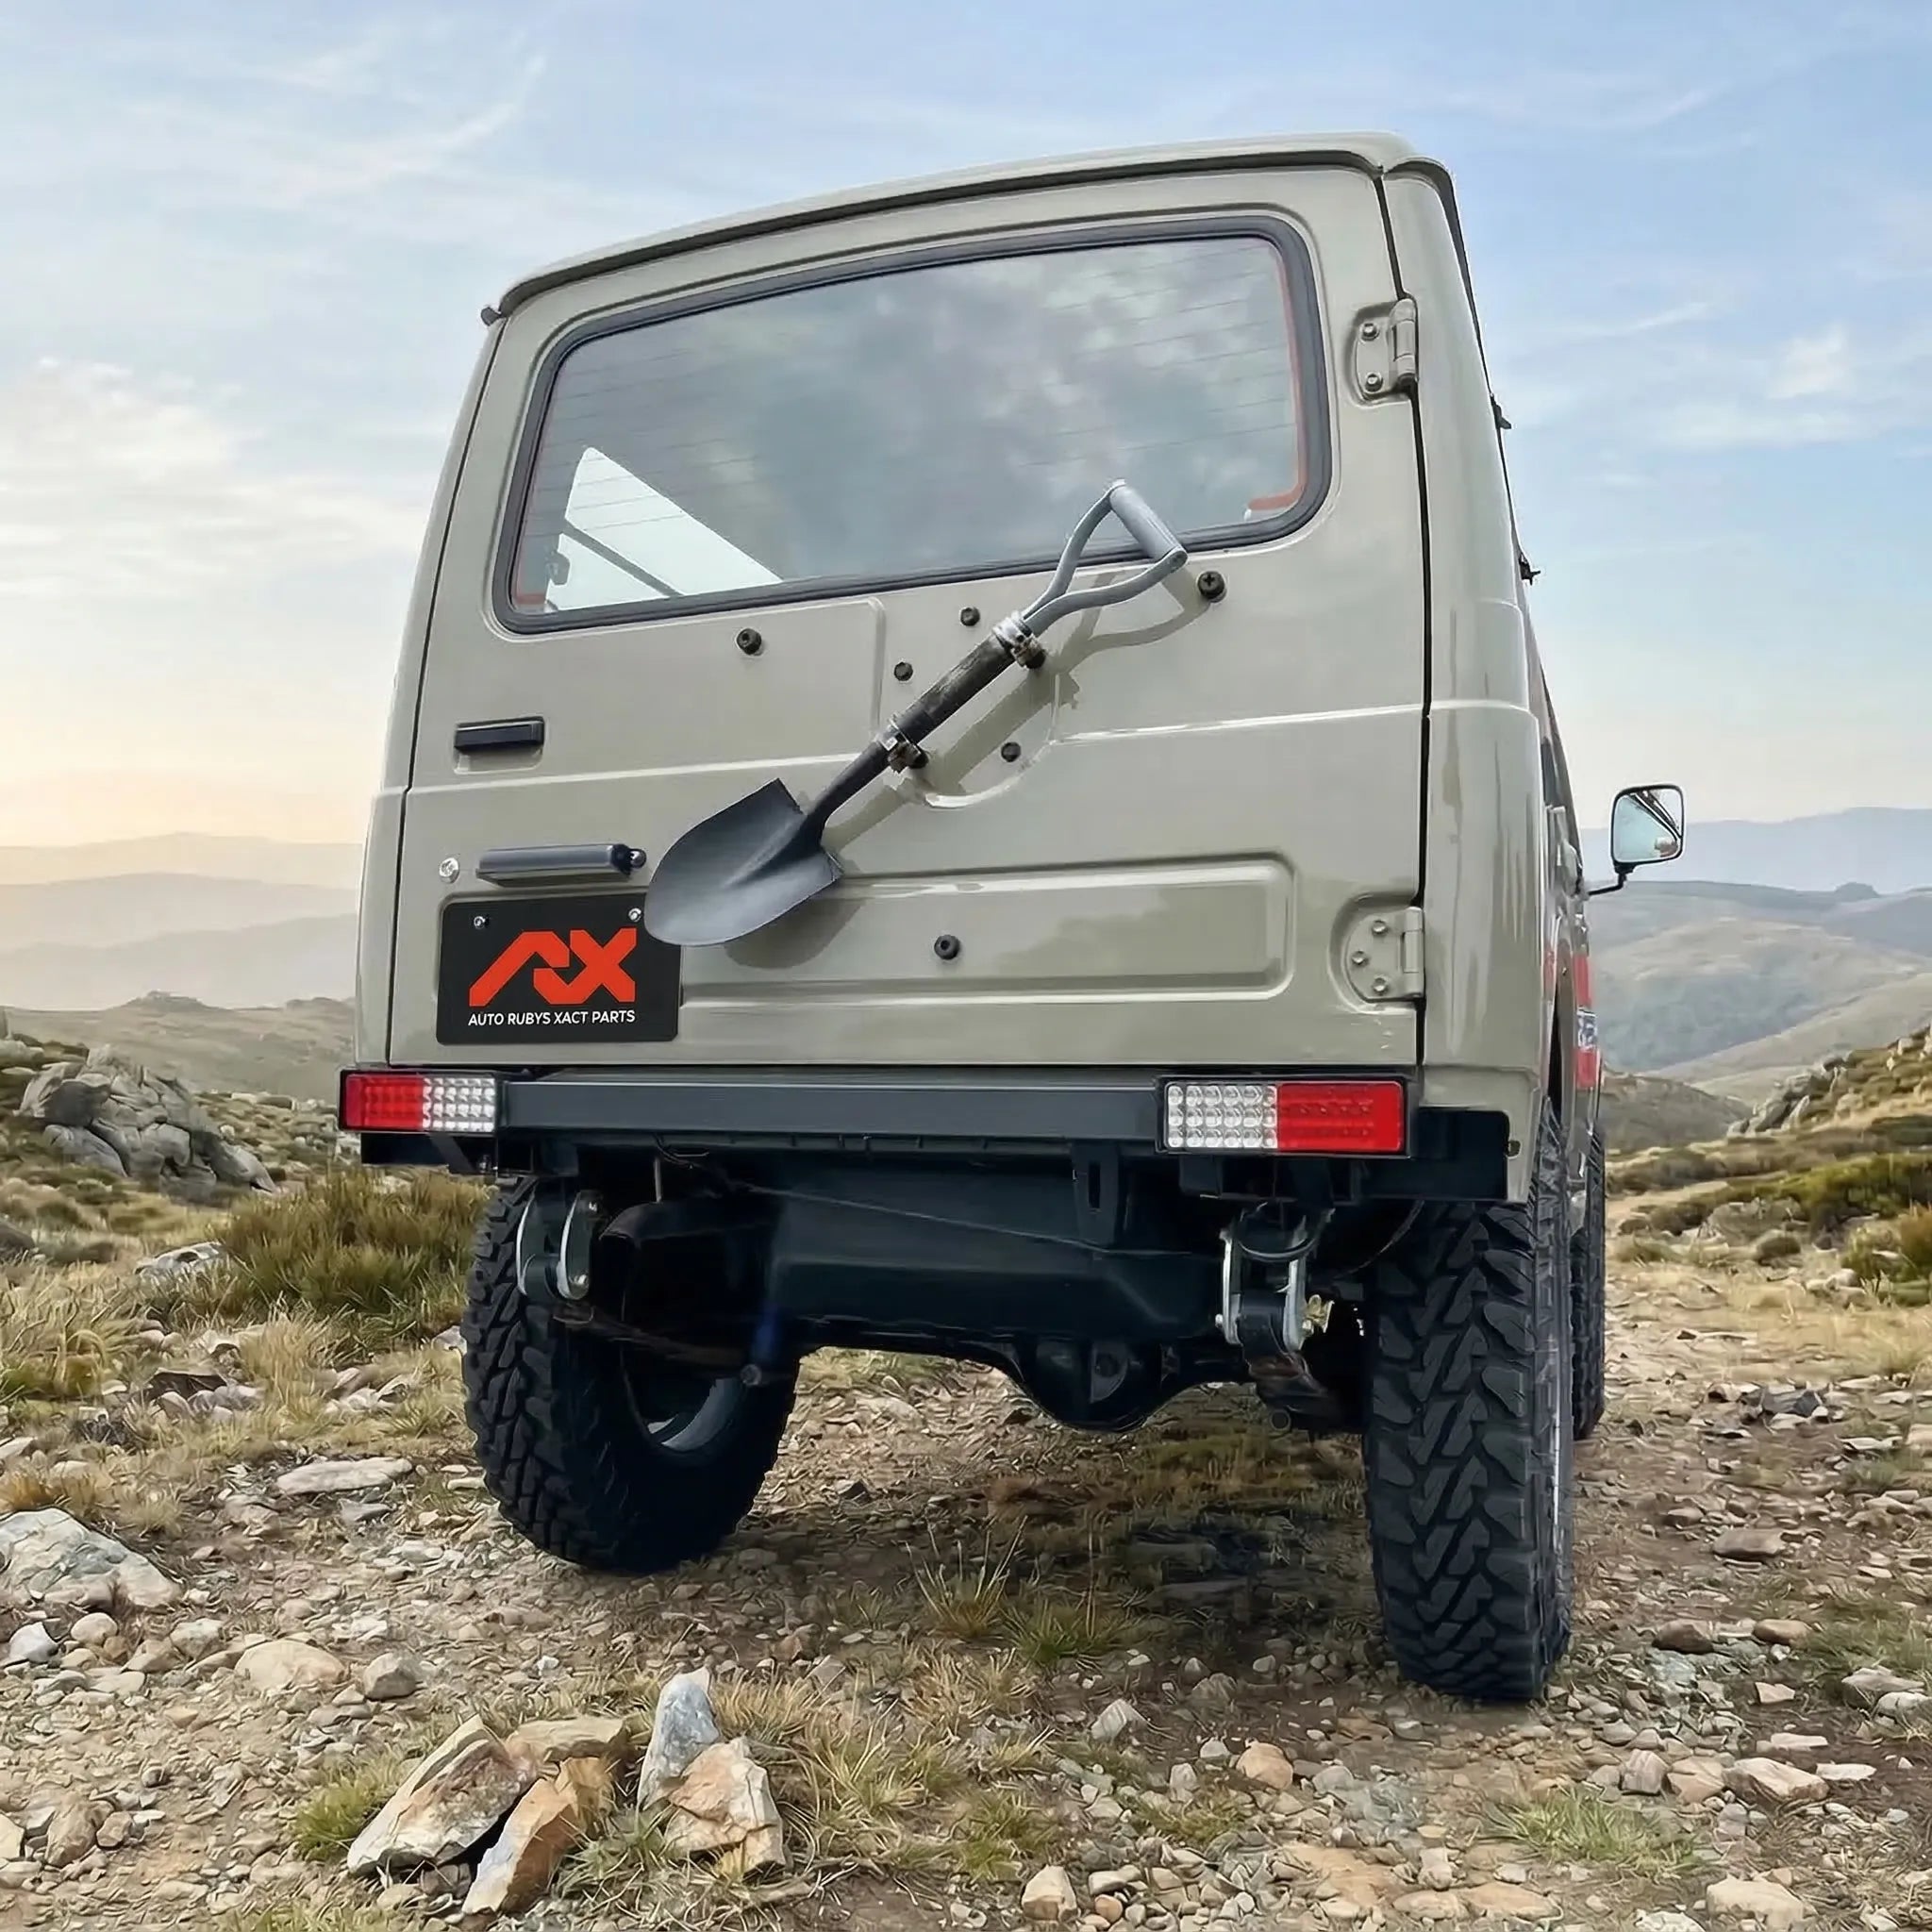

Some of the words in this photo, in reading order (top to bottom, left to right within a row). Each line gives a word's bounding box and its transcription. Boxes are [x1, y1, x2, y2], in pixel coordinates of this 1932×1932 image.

[467, 1012, 505, 1026] AUTO
[507, 1011, 552, 1025] RUBYS
[553, 1010, 589, 1024] XACT
[591, 1009, 636, 1024] PARTS
